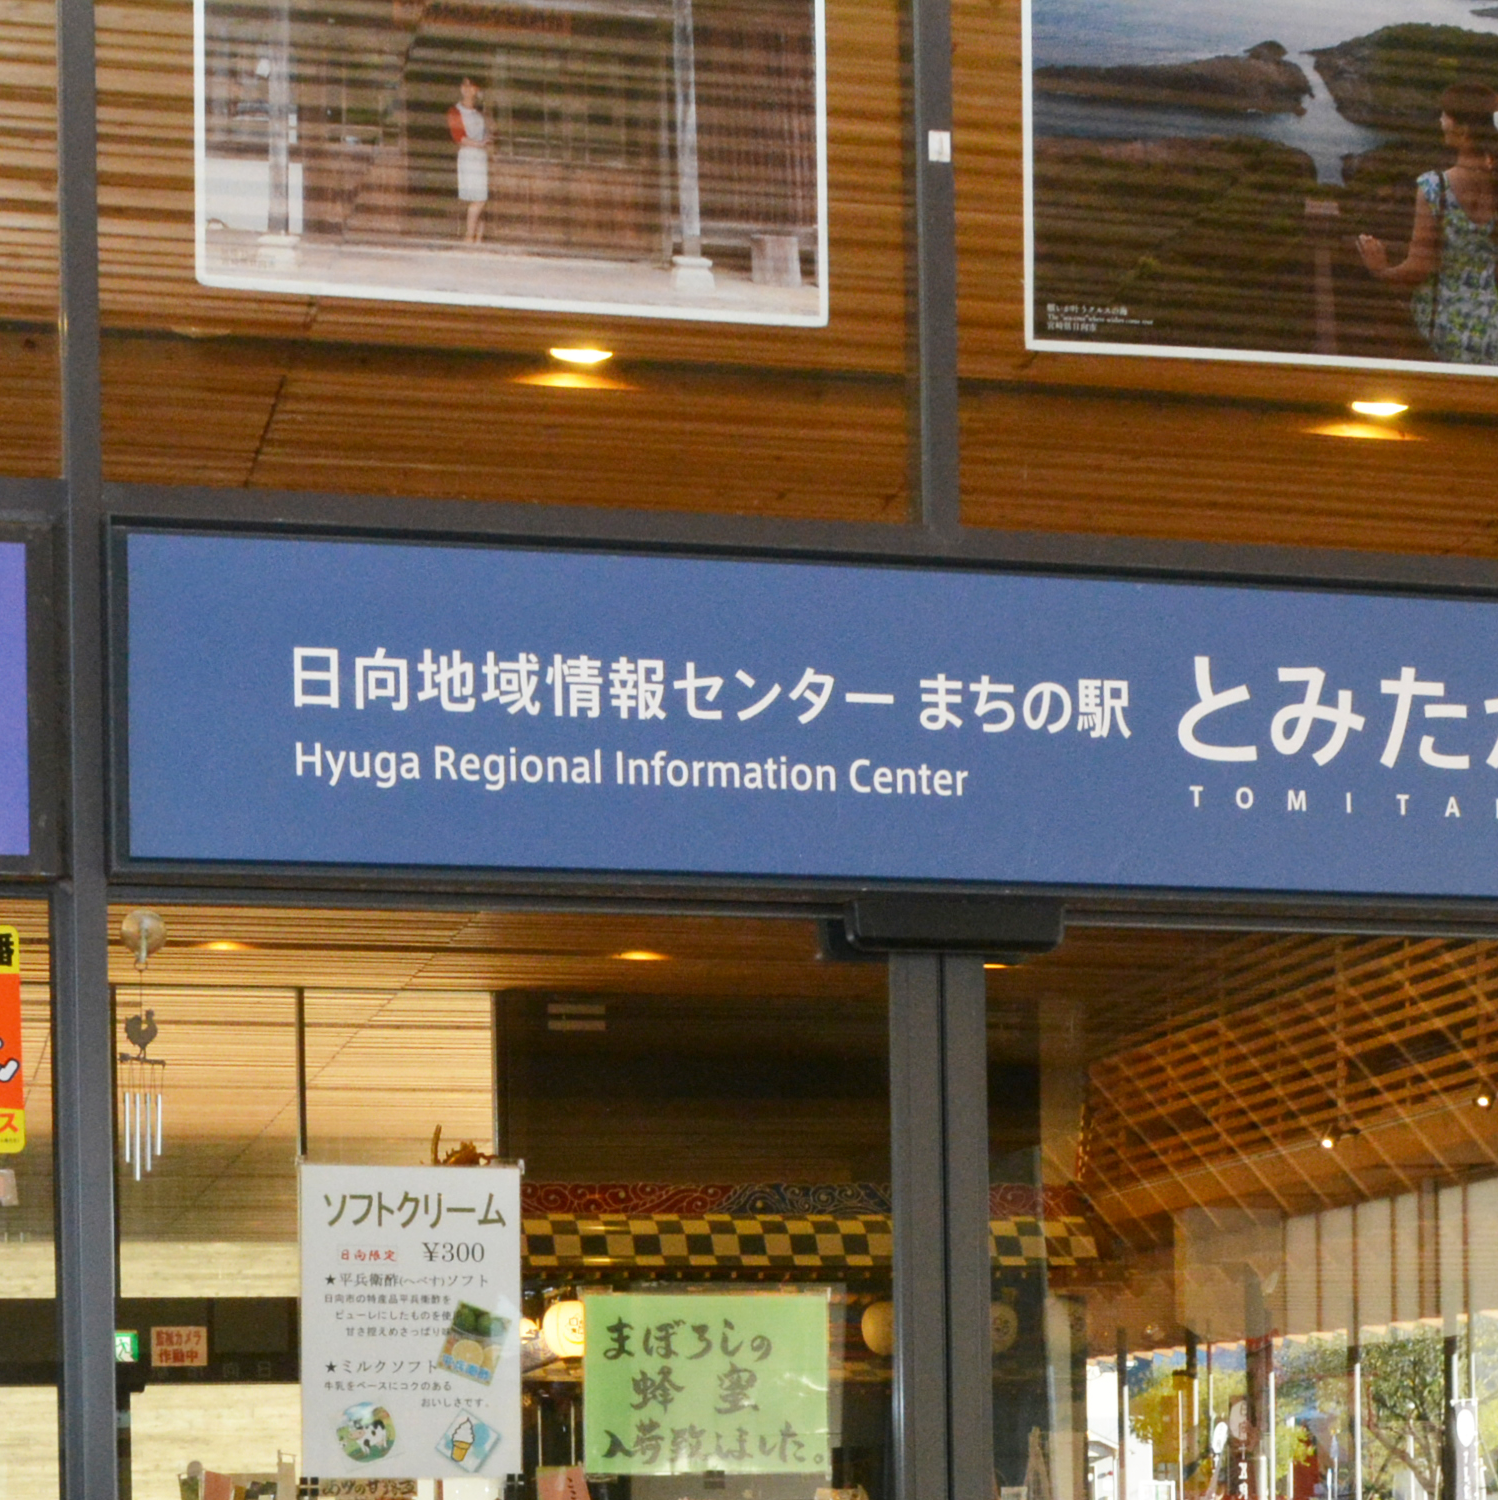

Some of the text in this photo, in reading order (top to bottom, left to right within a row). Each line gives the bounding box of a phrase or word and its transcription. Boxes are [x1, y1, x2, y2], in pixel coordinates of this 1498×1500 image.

[292, 646, 894, 723] 日向地域情報センター
[918, 672, 1131, 740] まちの駅
[295, 742, 968, 798] Hyuga Regional Information Center
[323, 1191, 507, 1230] ソフトクリーム
[341, 1242, 485, 1263] 日向限定 ¥300
[603, 1316, 772, 1362] まぼろしの
[341, 1359, 439, 1375] ミルクソフト
